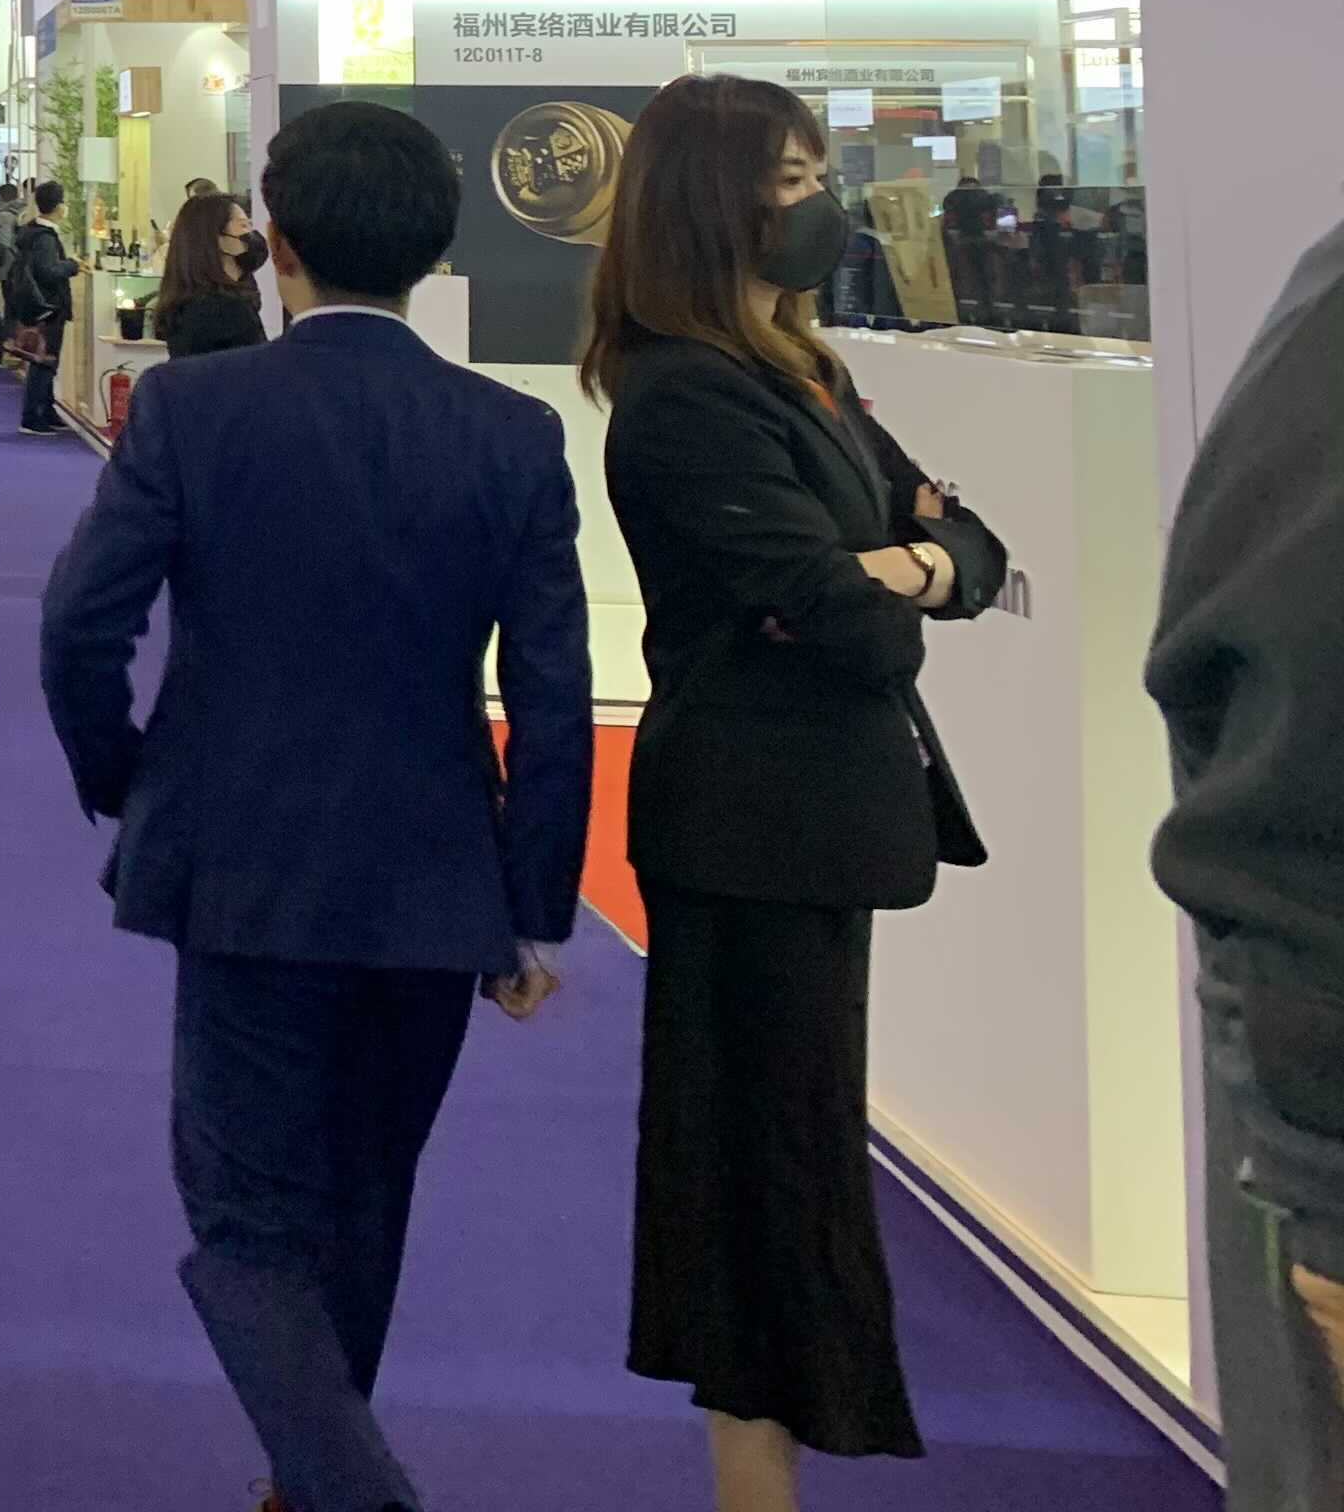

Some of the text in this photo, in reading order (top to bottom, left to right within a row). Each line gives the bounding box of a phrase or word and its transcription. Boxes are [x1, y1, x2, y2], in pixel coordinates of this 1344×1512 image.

[452, 11, 738, 39] 福州宾络酒业有限公司
[454, 47, 543, 63] 12C011T-8
